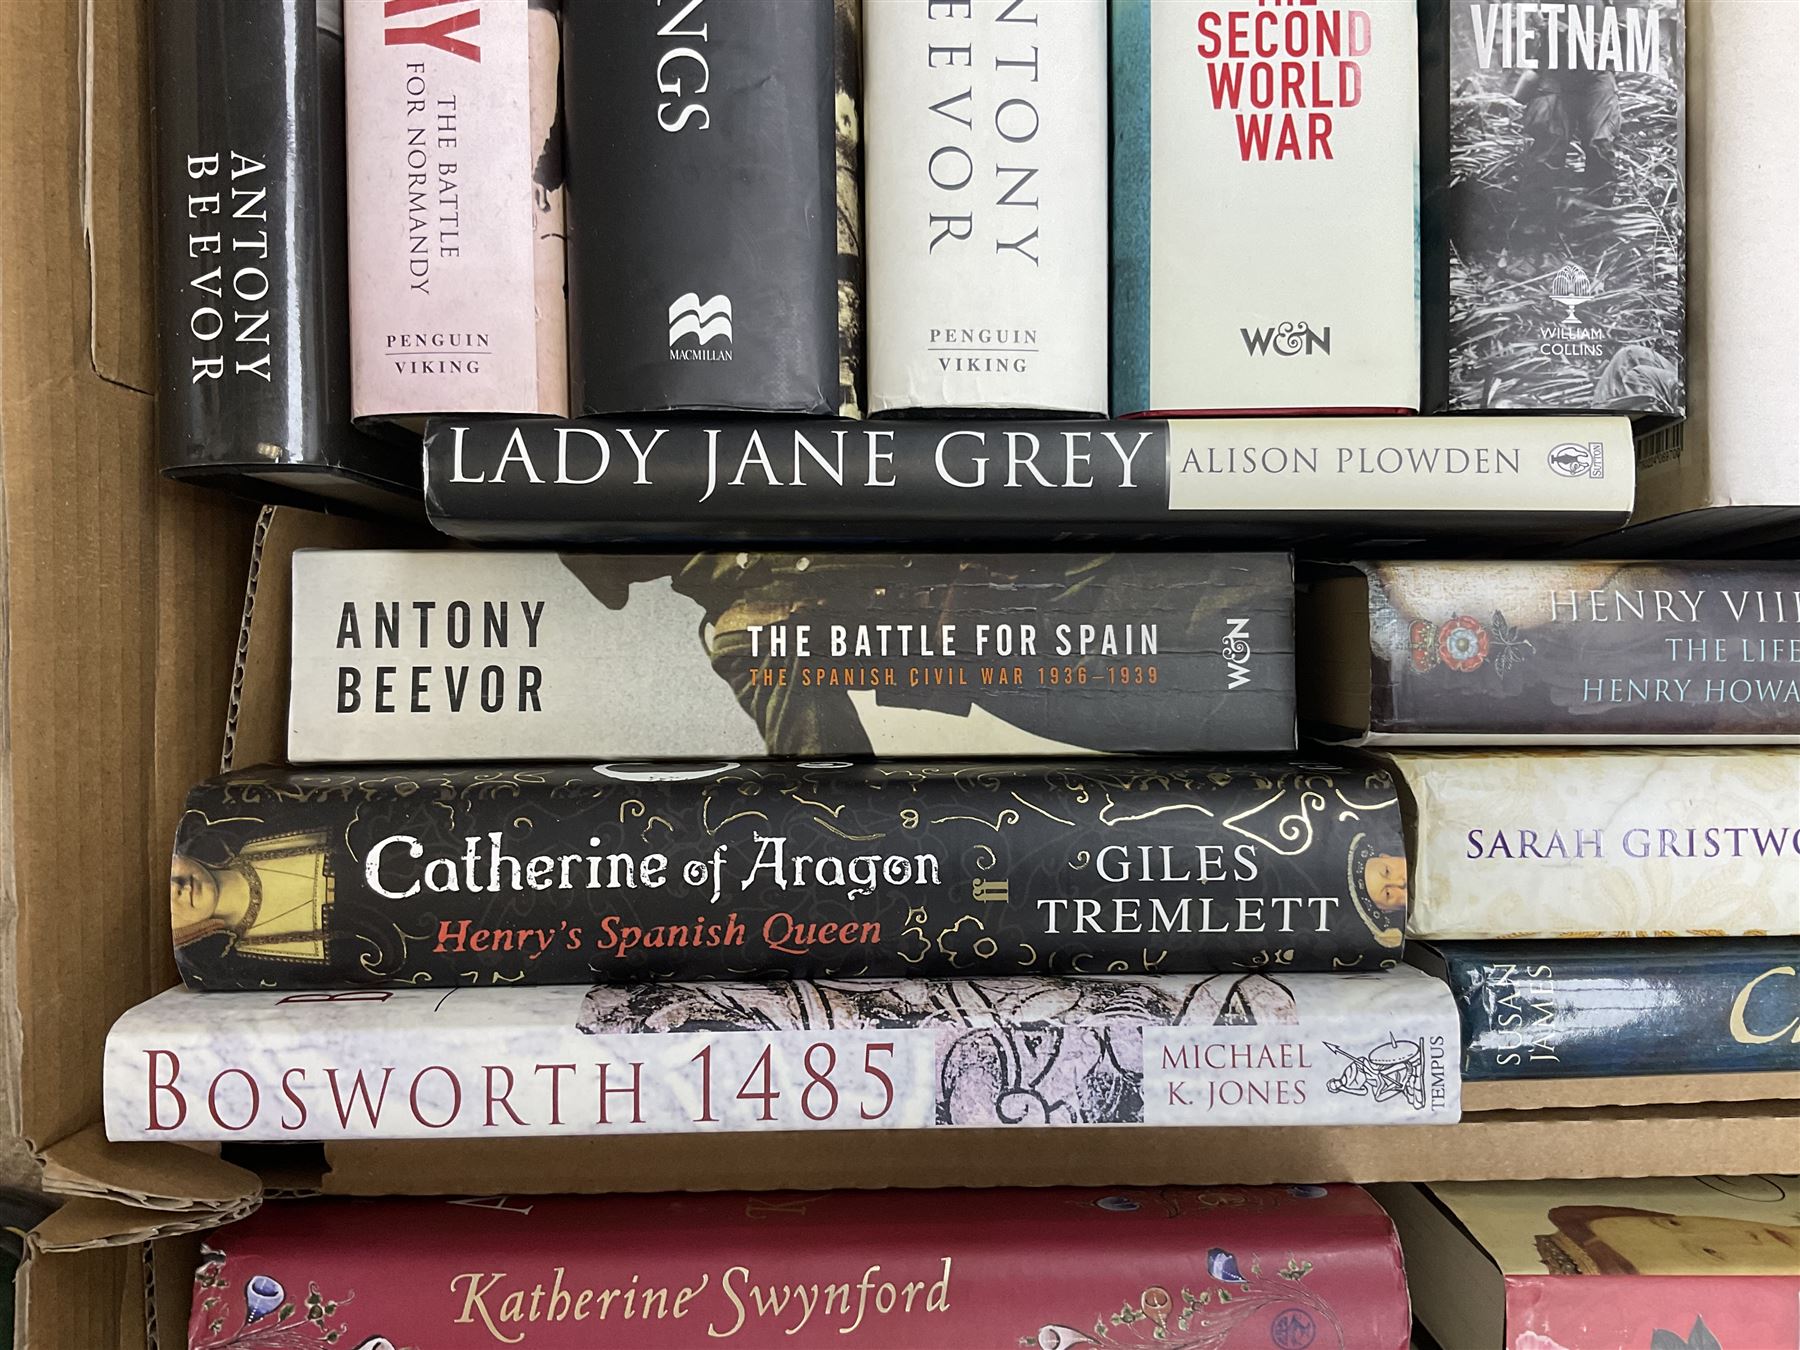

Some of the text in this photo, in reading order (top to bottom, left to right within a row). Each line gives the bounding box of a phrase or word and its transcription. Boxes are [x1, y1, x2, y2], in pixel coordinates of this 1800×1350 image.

[384, 0, 482, 64] Y
[1197, 10, 1372, 59] SECOND
[1470, 3, 1660, 74] VIETNAM
[1207, 61, 1362, 110] WORLD
[927, 0, 974, 255] EEVOR
[1235, 113, 1334, 161] WAR
[406, 62, 431, 296] FOR NORMANDY
[438, 95, 461, 259] THE BATTLE
[187, 154, 225, 384] BEEVOR
[230, 150, 271, 383] ANTONY
[386, 334, 490, 349] PENGUIN
[669, 350, 733, 361] MACMILLAN
[930, 329, 1037, 344] PENGUIN
[1240, 321, 1331, 358] W&N
[1540, 327, 1602, 340] WILLIAM
[1540, 343, 1603, 356] COLLINS
[395, 361, 481, 374] VIKING
[938, 358, 1028, 373] VIKING
[449, 427, 1153, 503] LADY JANE GREY
[1181, 446, 1521, 475] ALISON PLOWDEN
[1593, 445, 1602, 476] SUTTON
[336, 600, 545, 649] ANTONY
[1550, 589, 1706, 623] HENRY
[747, 622, 1158, 658] THE BATTLE FOR SPAIN
[1222, 618, 1251, 690] W&N
[1665, 638, 1800, 664] THE LIFE
[337, 664, 543, 714] BEEVOR
[750, 668, 788, 687] THE
[802, 667, 896, 687] SPANISH
[909, 667, 967, 687] CIVIL
[980, 667, 1025, 685] WAR
[1583, 678, 1692, 703] HENRY
[364, 830, 942, 903] Catherine of Aragon
[1096, 844, 1259, 883] GILES
[1466, 827, 1800, 860] SARAH GRISTW
[433, 912, 882, 961] Henry's Spanish Queen
[1037, 897, 1339, 935] TREMLETT
[1493, 964, 1523, 1066] SUSAN
[1526, 965, 1561, 1063] JAMES
[1161, 1043, 1313, 1070] MICHAEL
[1430, 1035, 1446, 1112] TEMPUS
[690, 1042, 896, 1125] 1485
[1168, 1079, 1307, 1111] K. JONES
[449, 1257, 953, 1344] Katherine Swynford
